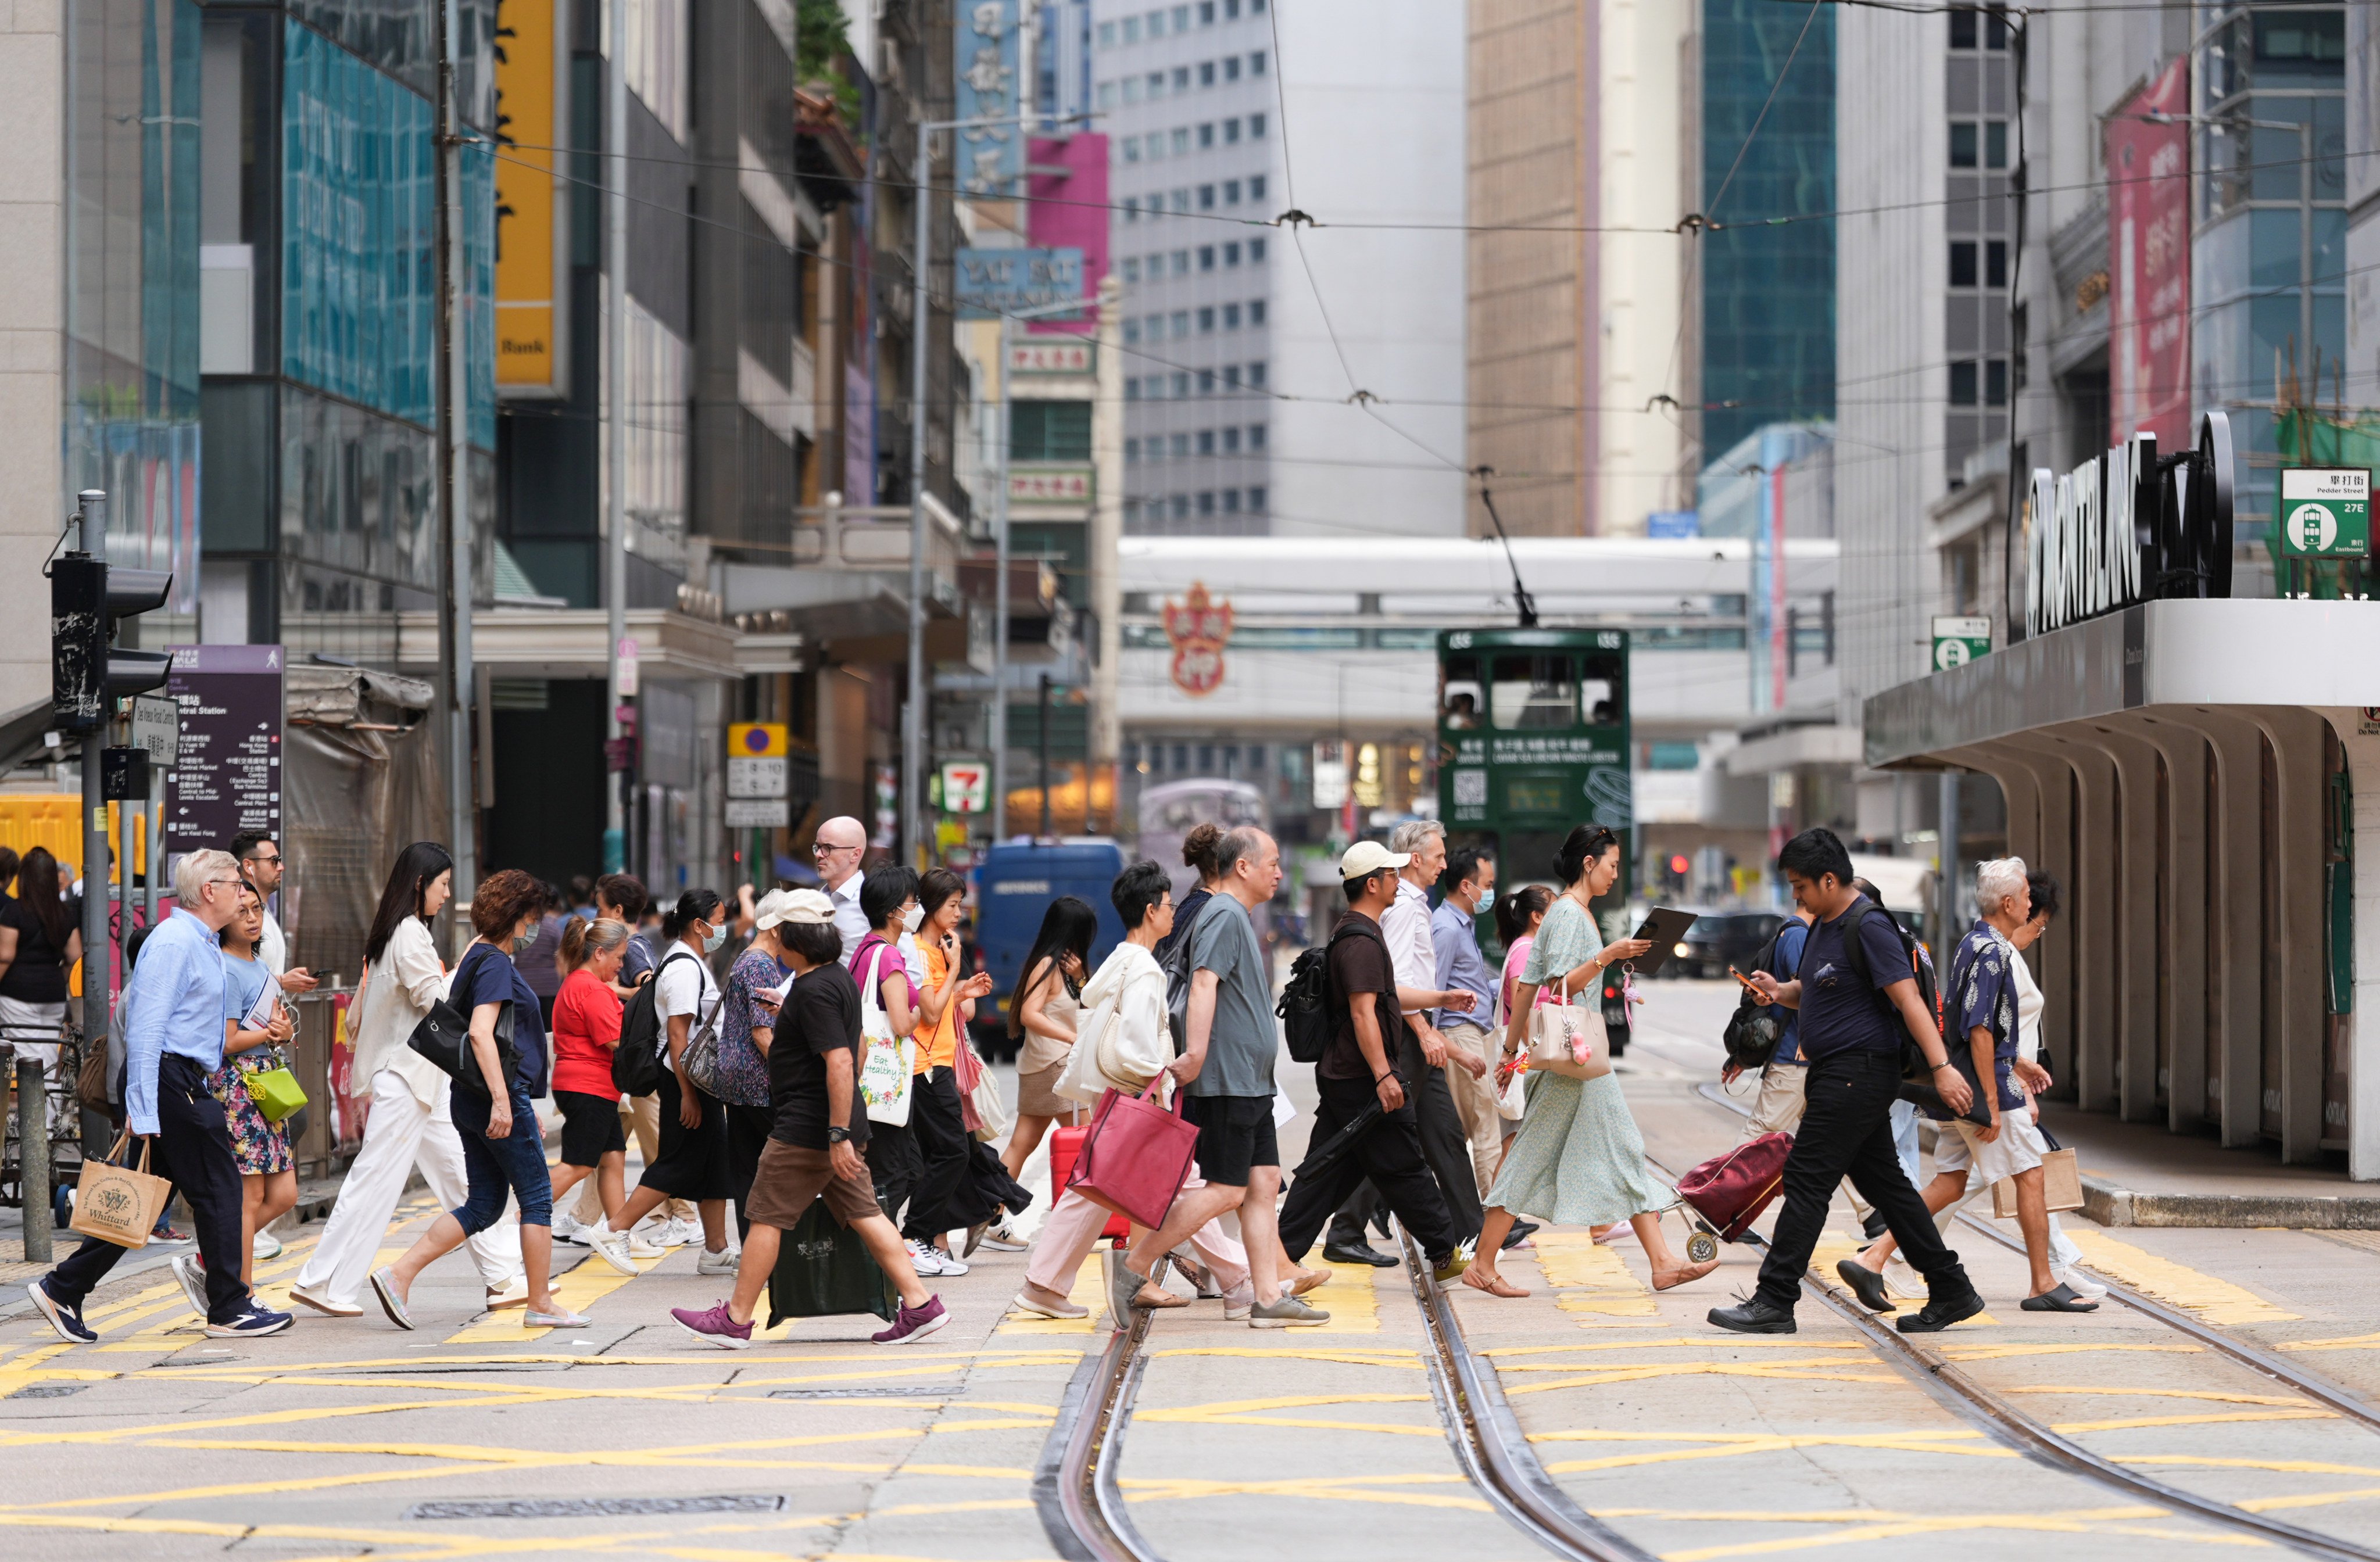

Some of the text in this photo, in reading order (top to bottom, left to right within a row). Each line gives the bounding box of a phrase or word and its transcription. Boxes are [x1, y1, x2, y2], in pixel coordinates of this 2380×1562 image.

[502, 341, 545, 354] Bank
[2331, 475, 2364, 486] 畢打街
[2345, 504, 2364, 513] 27E
[874, 1055, 888, 1066] Eat
[865, 1065, 897, 1080] Healthy
[85, 1188, 94, 1202] Finest
[89, 1209, 130, 1227] Whittard
[92, 1219, 112, 1228] CHELSEA
[997, 1230, 1010, 1241] N
